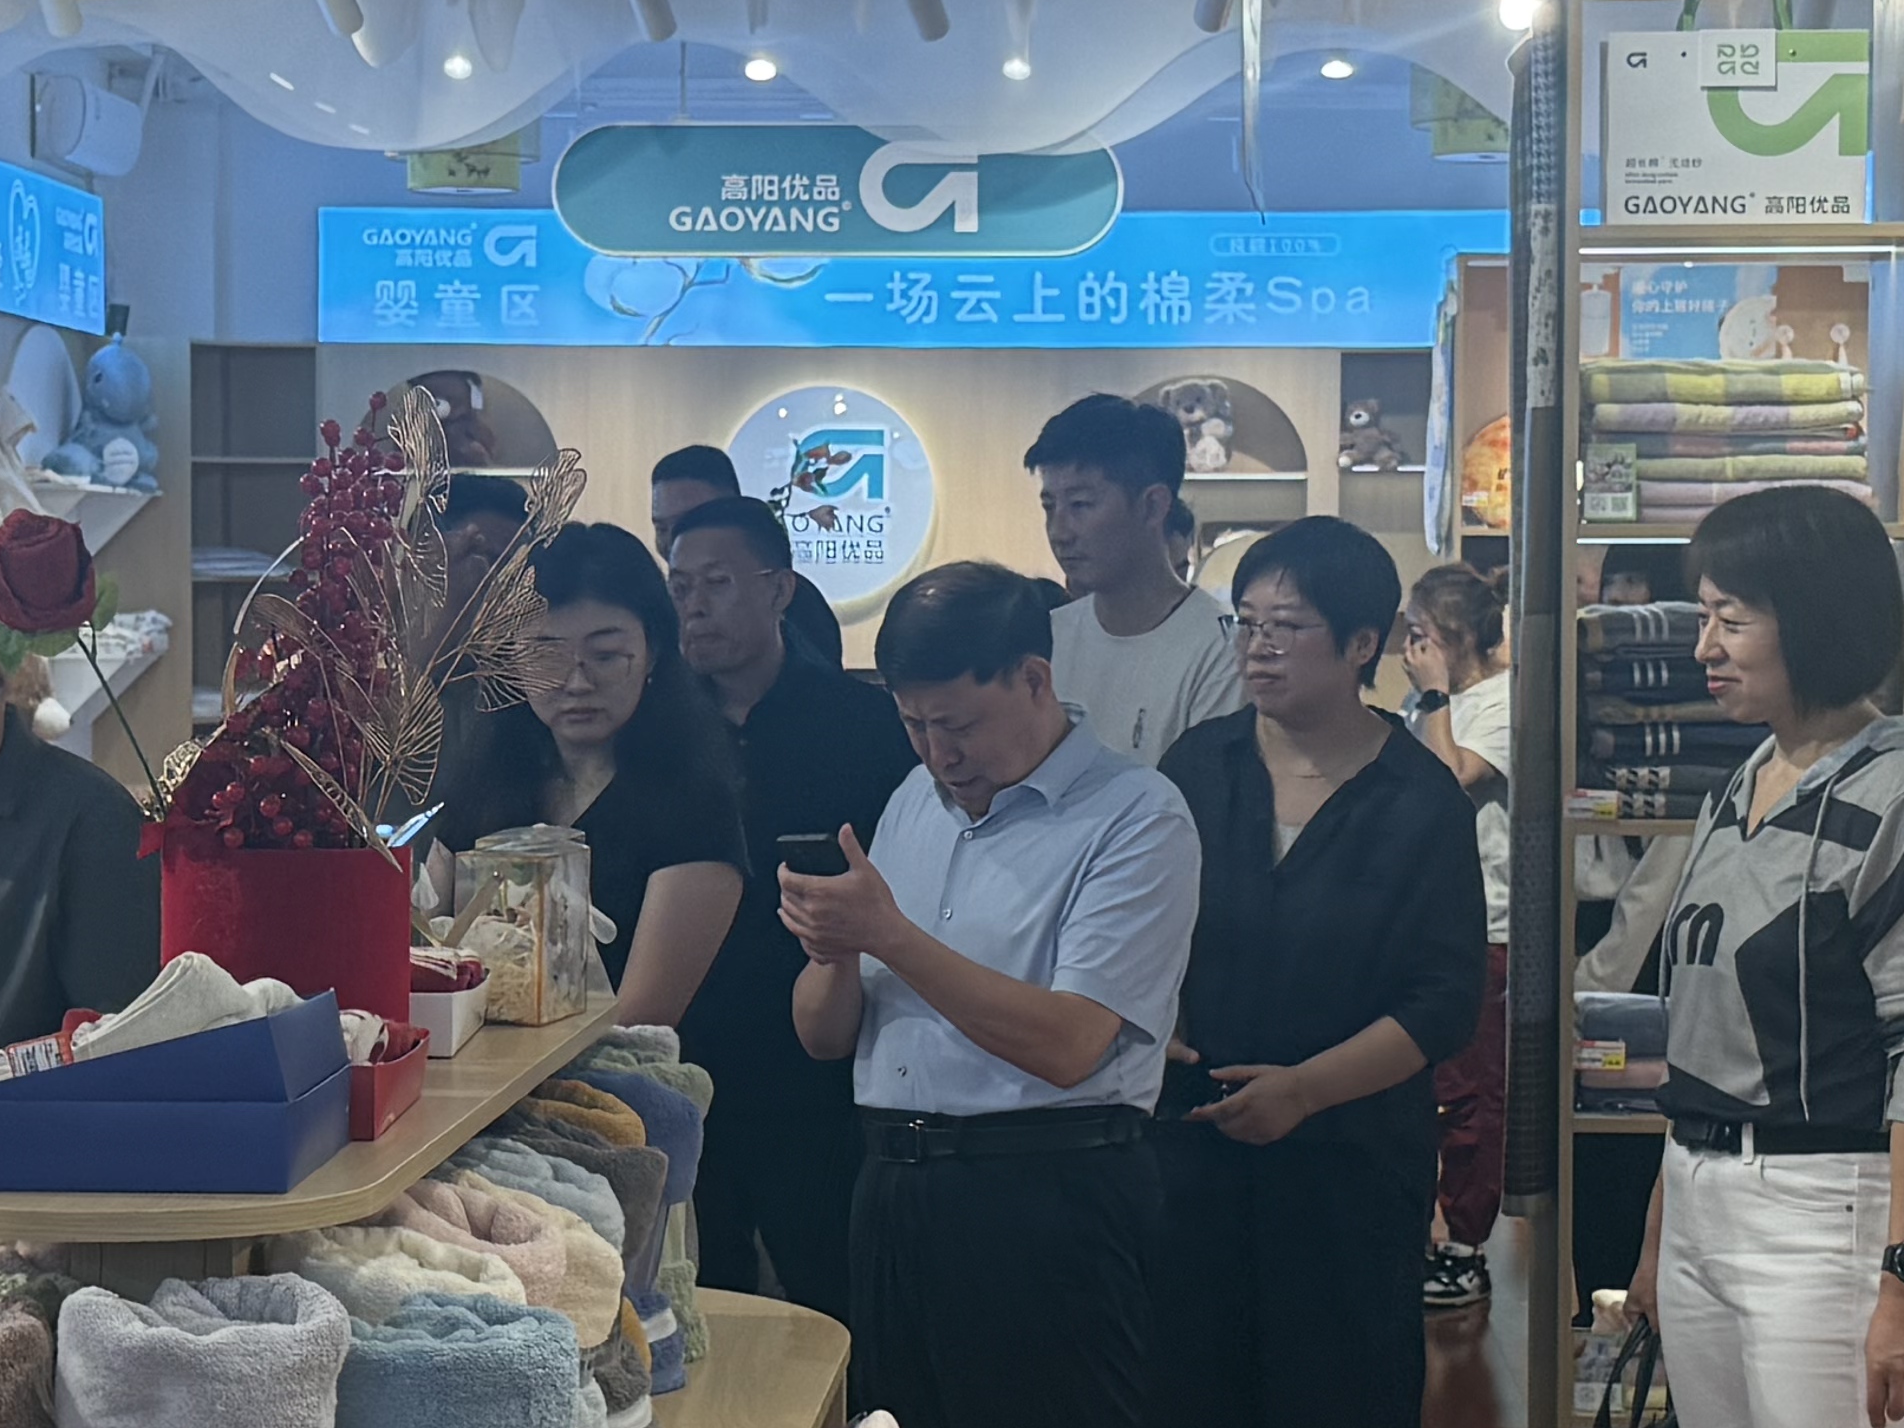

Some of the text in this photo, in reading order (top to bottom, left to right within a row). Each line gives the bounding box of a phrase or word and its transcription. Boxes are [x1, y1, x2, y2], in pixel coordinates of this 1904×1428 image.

[720, 173, 841, 201] 高阳优品
[1624, 194, 1851, 215] GAOYANG 高阳优品
[668, 205, 840, 233] GAOYANG
[362, 228, 472, 246] GAOYANG
[395, 248, 472, 268] 高阳优品
[373, 278, 541, 328] 婴童区
[823, 268, 1373, 326] 一场云上的棉柔Spa
